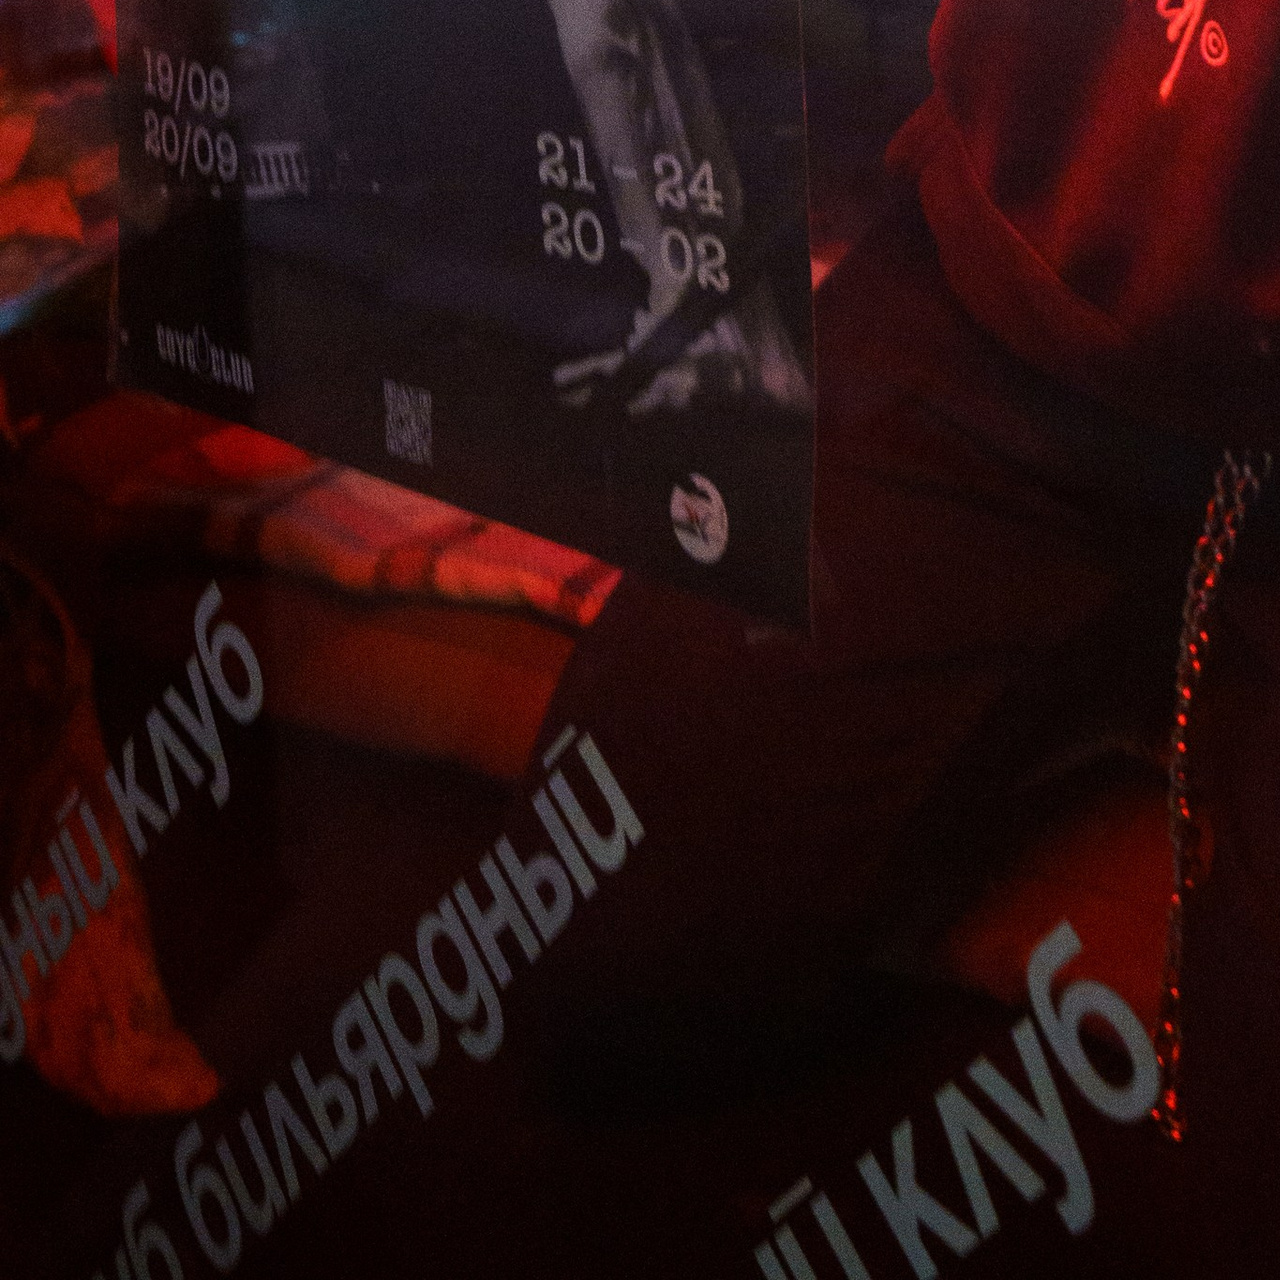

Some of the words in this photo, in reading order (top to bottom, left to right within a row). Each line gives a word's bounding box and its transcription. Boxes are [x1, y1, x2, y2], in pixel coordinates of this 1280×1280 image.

[142, 44, 231, 119] 19/09
[143, 107, 238, 184] 20/09
[536, 130, 597, 195] 21
[652, 151, 725, 220] 24
[540, 200, 606, 265] 20
[659, 225, 731, 294] 02
[104, 578, 265, 858] клуб
[173, 723, 647, 1273] бильярдный
[854, 919, 1162, 1280] клуб
